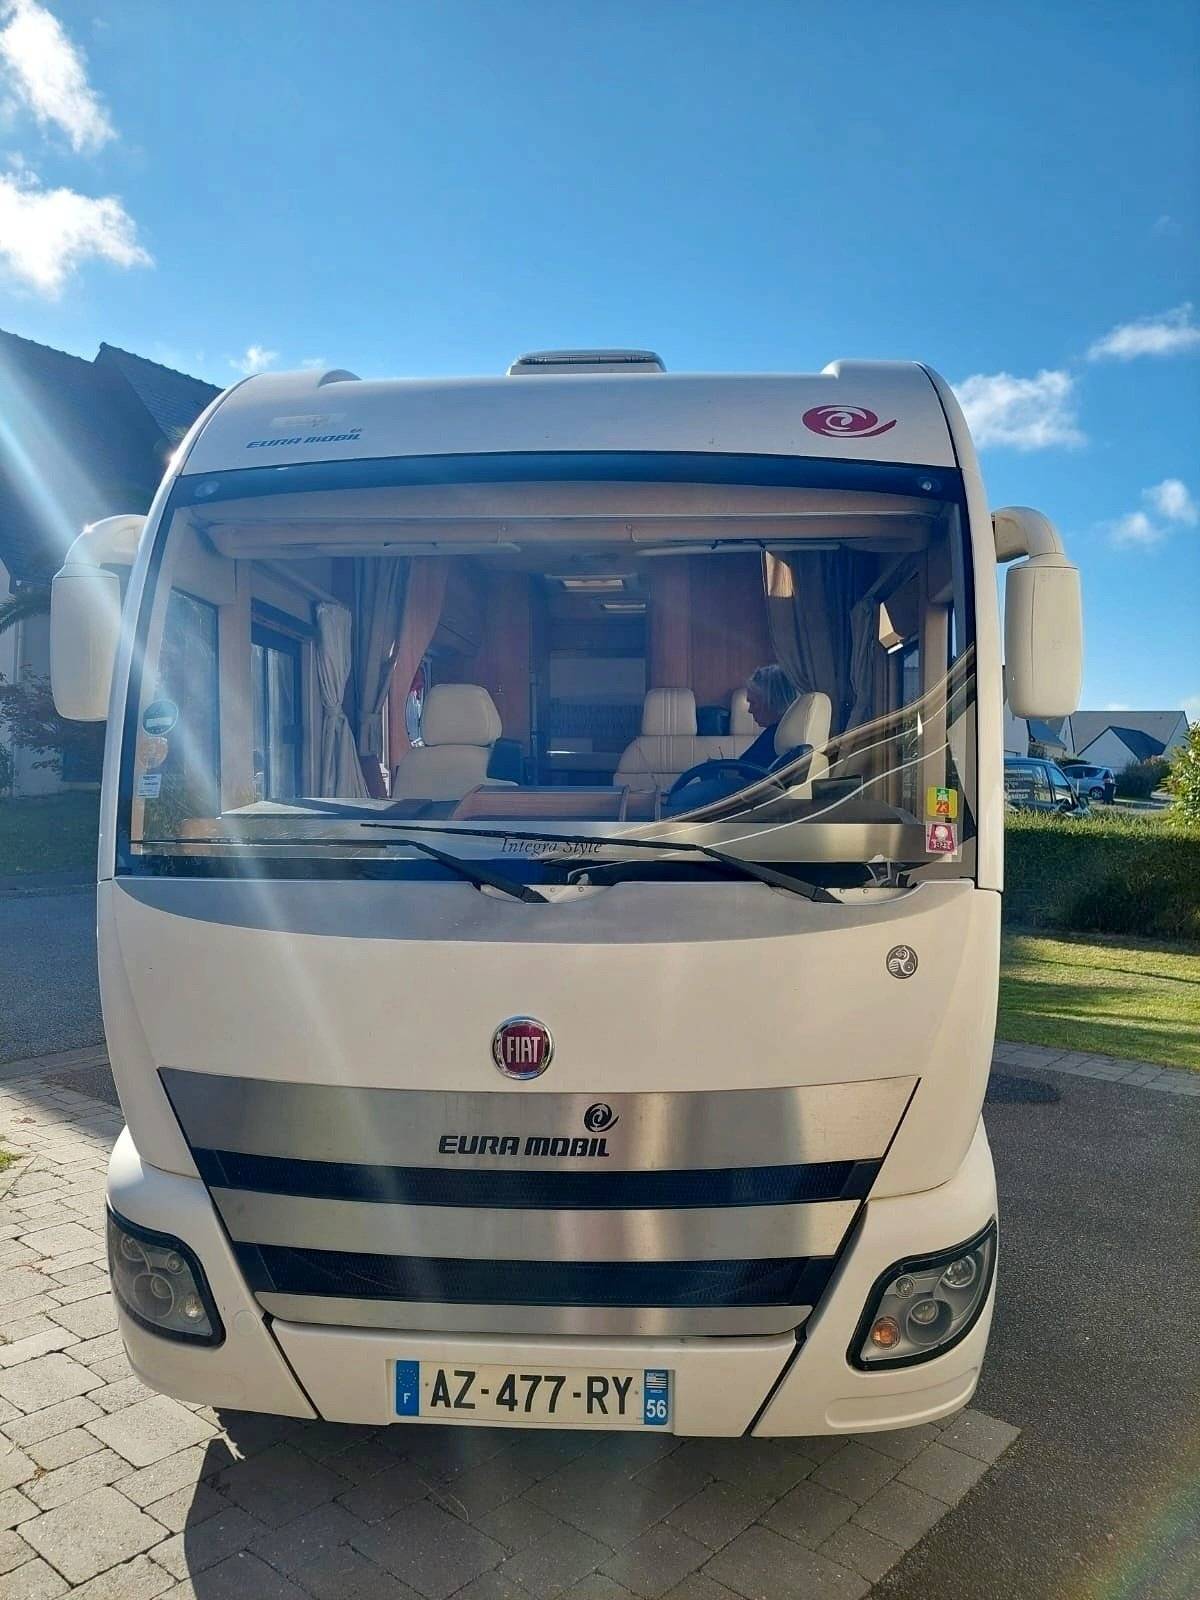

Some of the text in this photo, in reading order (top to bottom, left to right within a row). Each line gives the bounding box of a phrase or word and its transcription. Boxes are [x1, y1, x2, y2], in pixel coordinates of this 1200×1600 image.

[501, 838, 557, 856] Integra
[506, 1036, 541, 1063] FIAT
[439, 1135, 610, 1157] EURA MOBIL
[403, 1393, 411, 1404] F
[430, 1369, 633, 1415] AZ-477-RY
[646, 1399, 668, 1419] 56
